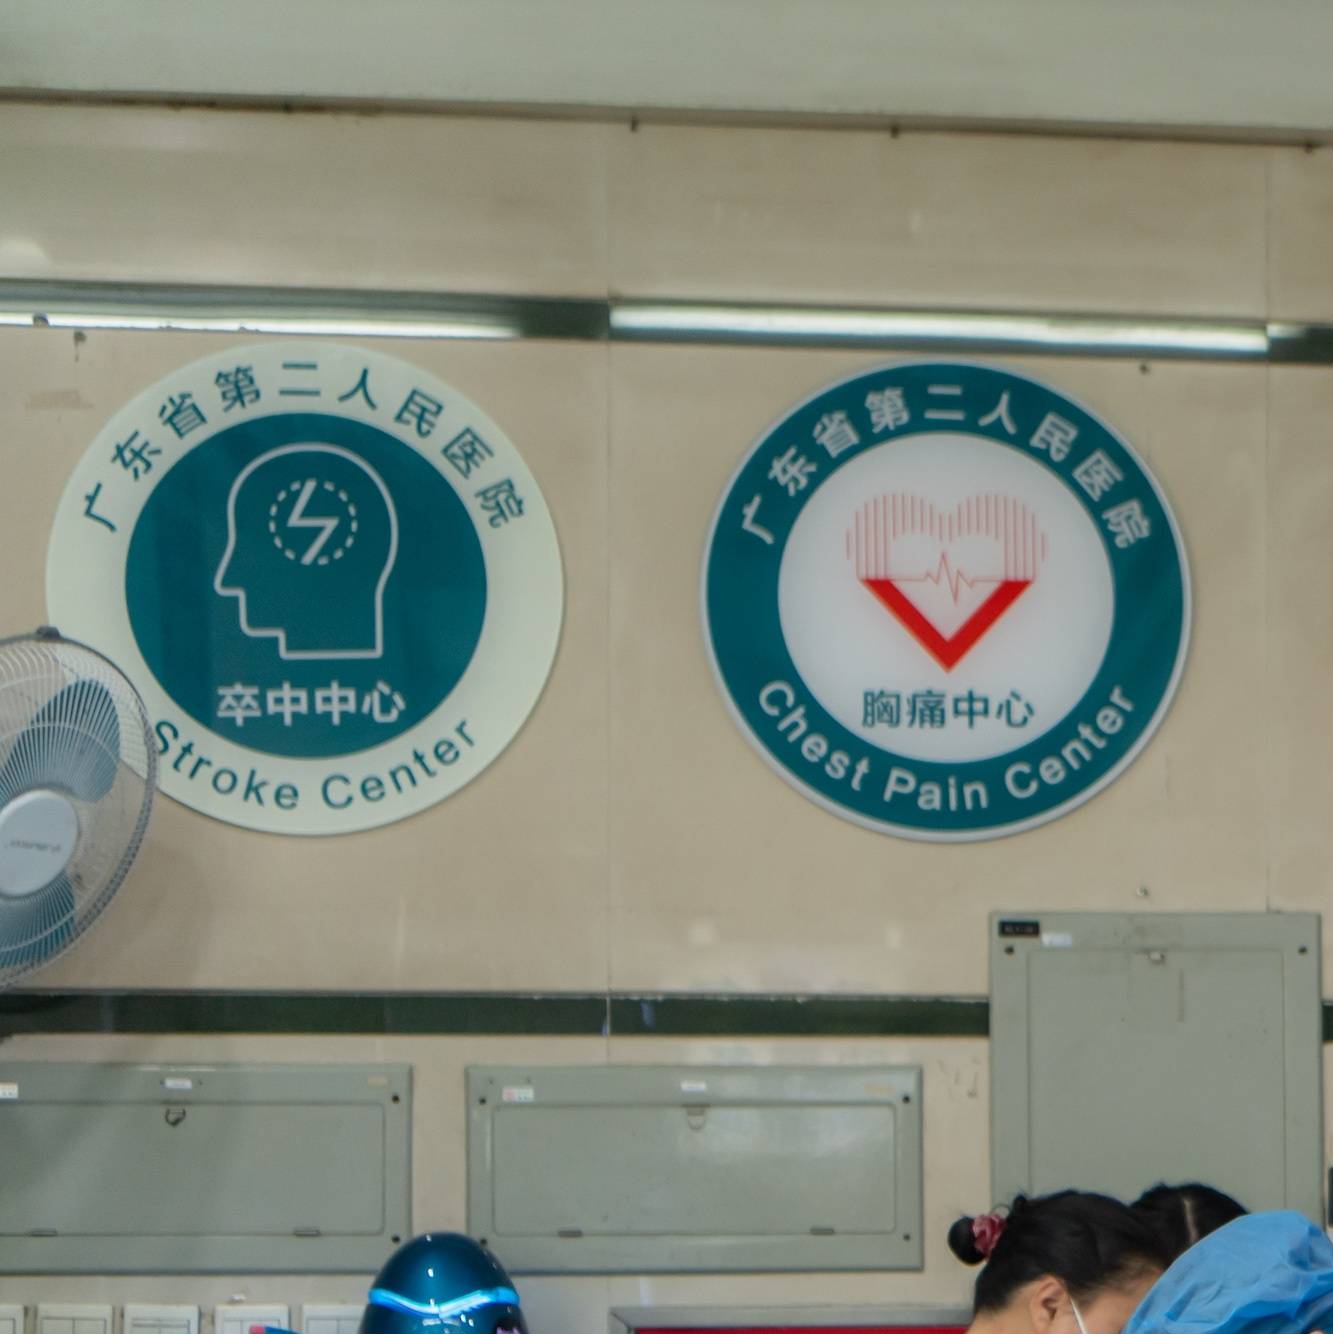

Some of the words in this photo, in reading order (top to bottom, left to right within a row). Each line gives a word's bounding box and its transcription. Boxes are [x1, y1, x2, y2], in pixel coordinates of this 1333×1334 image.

[82, 362, 526, 533] 广东省第二人民医院
[741, 384, 1152, 549] 广东省第二人民医院
[216, 681, 406, 727] 卒中中心
[758, 681, 870, 791] Chest
[883, 767, 989, 811] Pain
[1004, 686, 1136, 799] Center
[862, 690, 1035, 729] 胸痛中心
[155, 719, 299, 811] Stroke
[321, 718, 474, 810] Center
